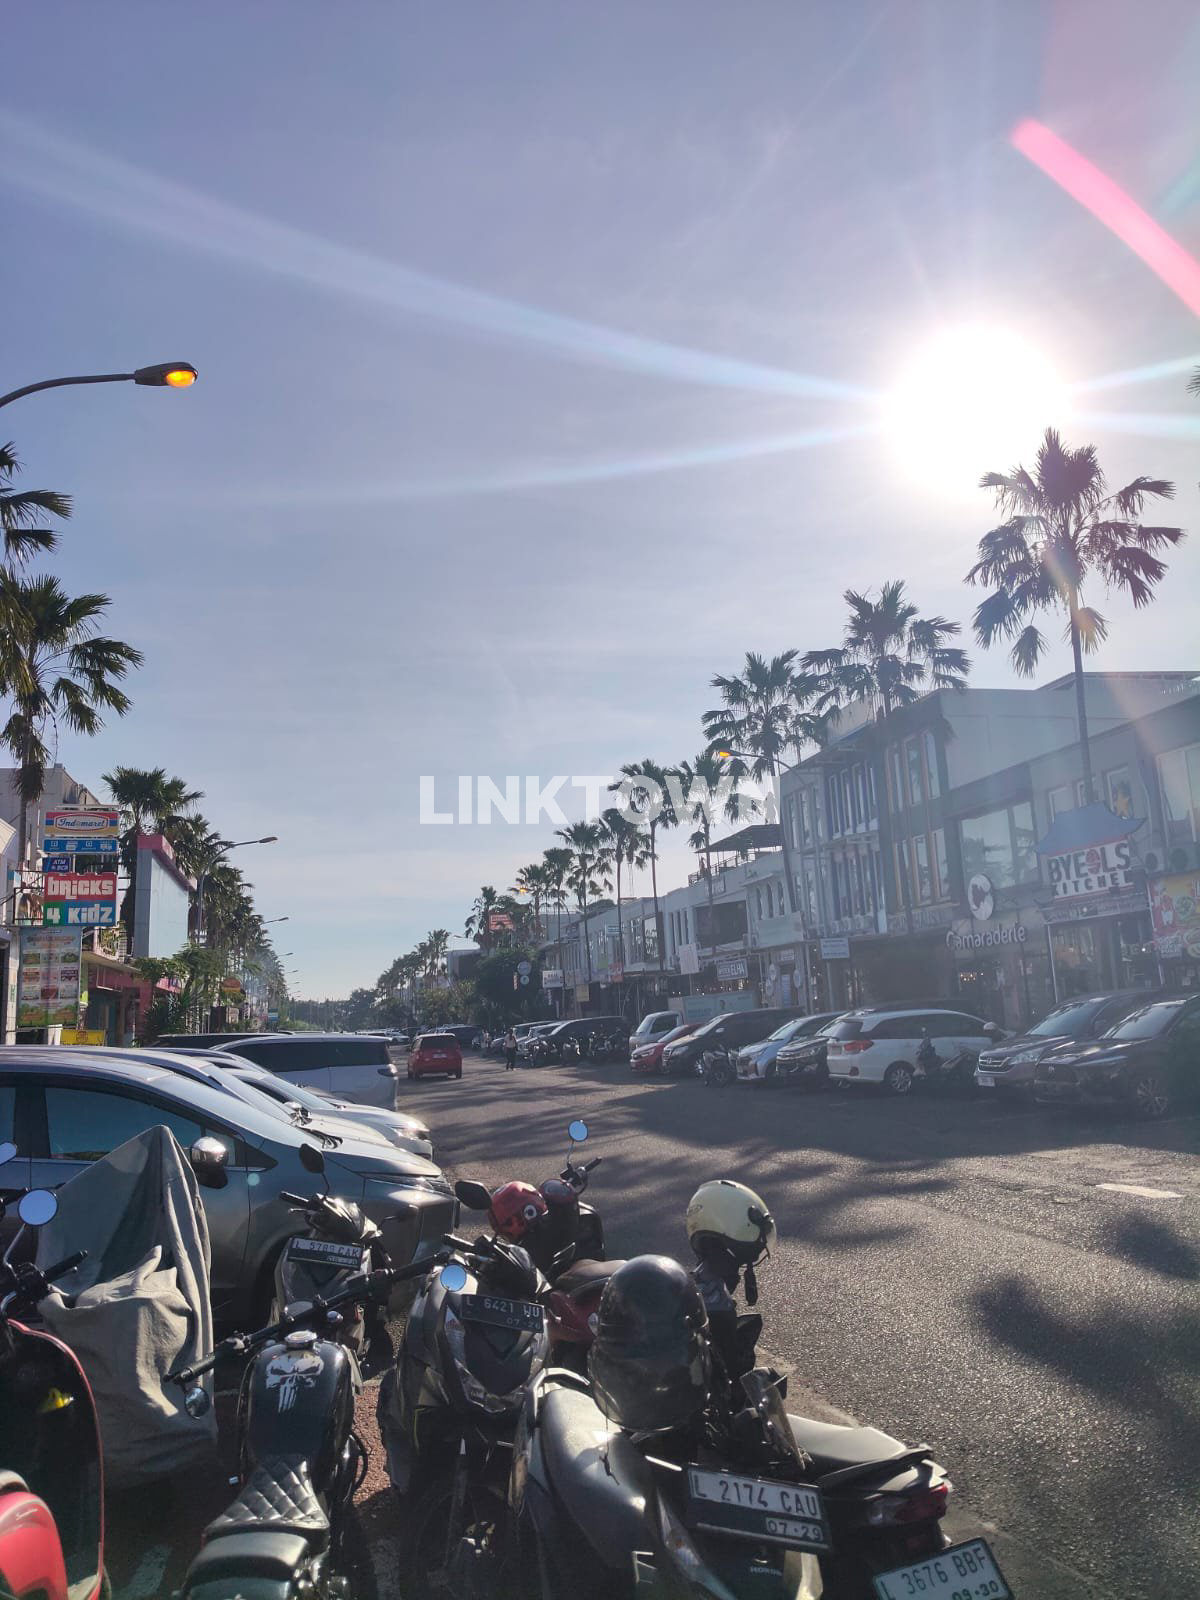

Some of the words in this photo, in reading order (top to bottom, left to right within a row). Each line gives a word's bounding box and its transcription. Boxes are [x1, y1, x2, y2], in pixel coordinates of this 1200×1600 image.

[57, 818, 105, 827] Indomaret
[46, 907, 61, 924] 4
[945, 921, 1026, 949] Camaraderie
[484, 1298, 514, 1313] 6421
[694, 1475, 708, 1498] L
[719, 1480, 768, 1508] 2174
[780, 1490, 818, 1517] CAU
[880, 1581, 897, 1600] L
[901, 1562, 949, 1595] 3676
[951, 1547, 986, 1577] BBF
